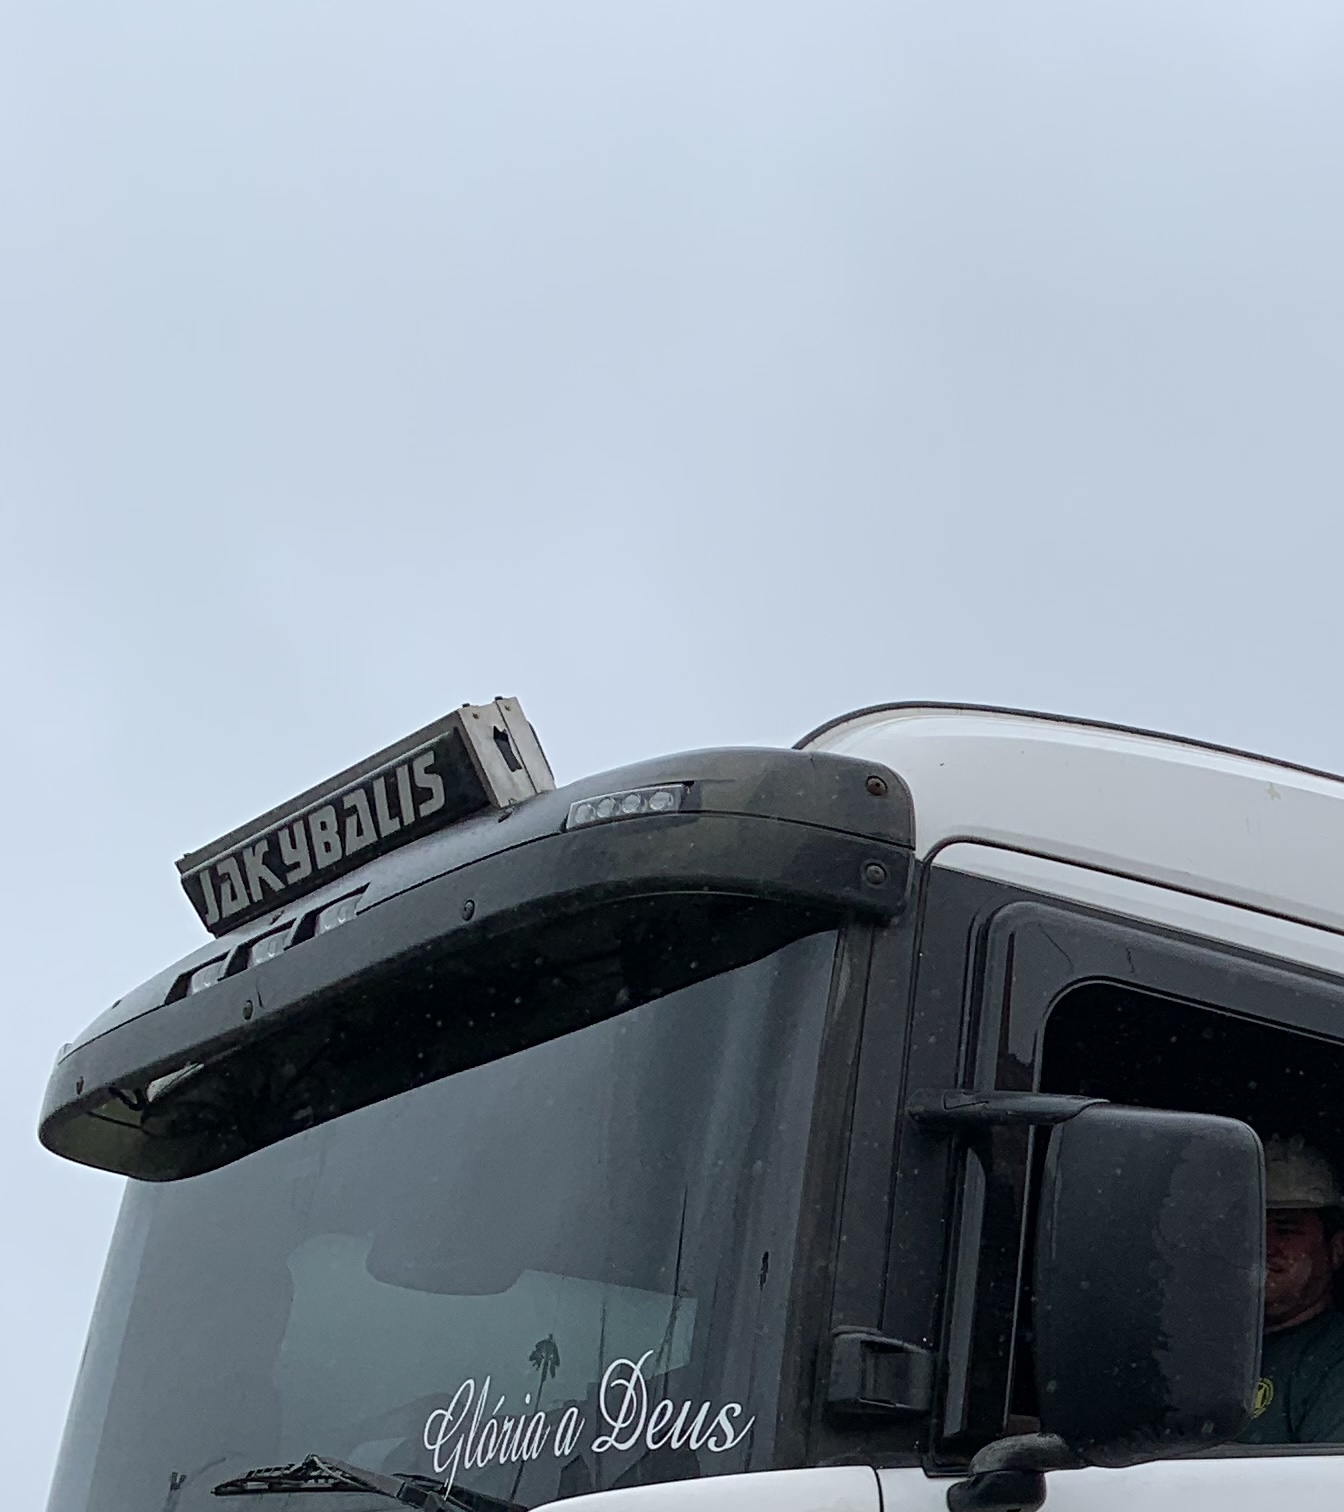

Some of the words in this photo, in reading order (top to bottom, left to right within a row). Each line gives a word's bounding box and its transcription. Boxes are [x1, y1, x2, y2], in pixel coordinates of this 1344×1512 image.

[423, 1375, 550, 1501] Glória
[553, 1406, 586, 1457] a
[591, 1349, 755, 1452] Deus
